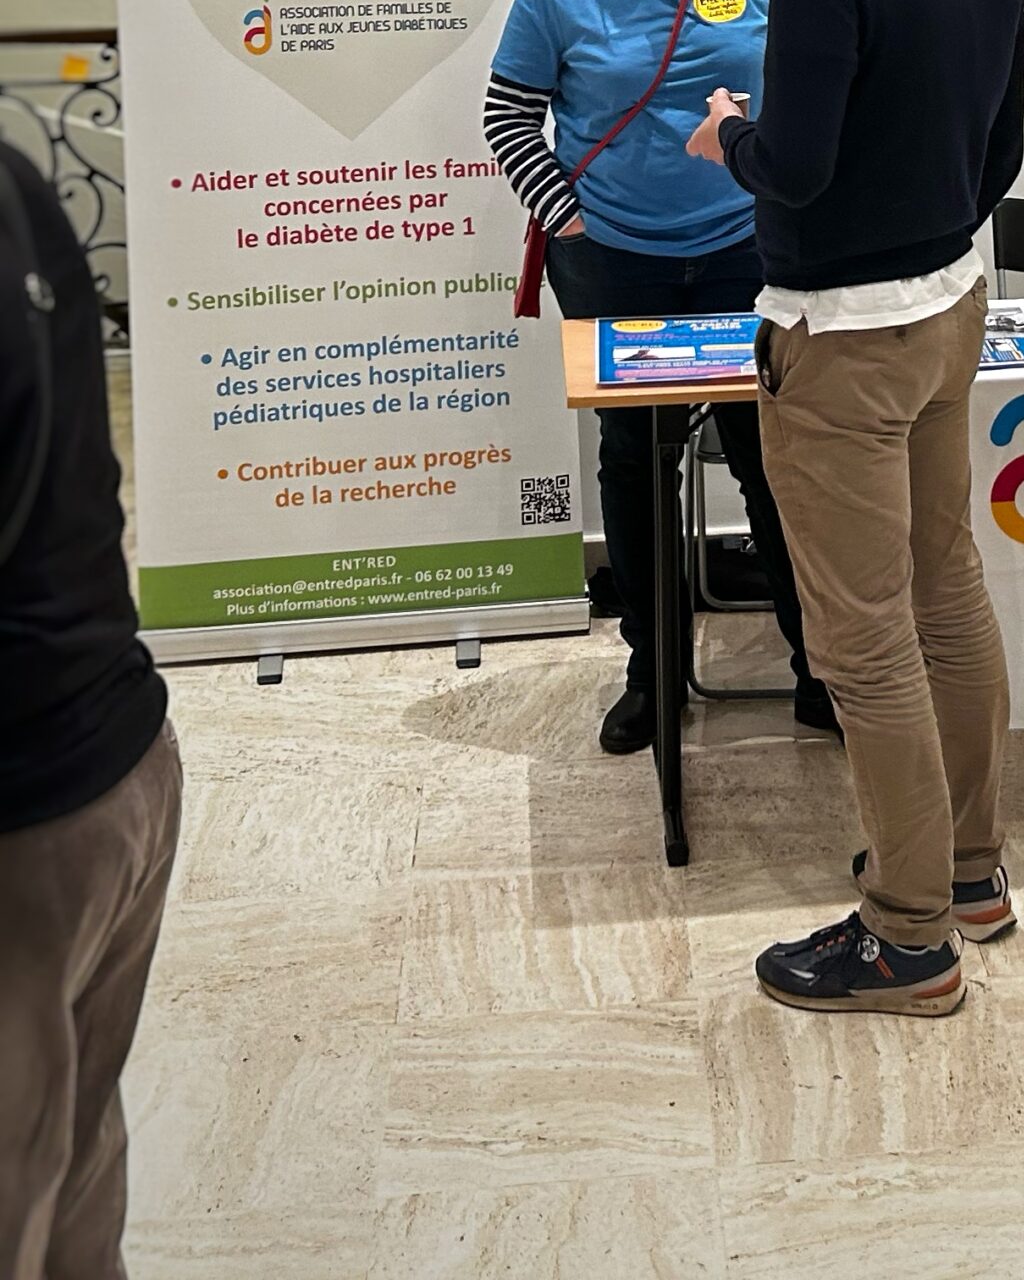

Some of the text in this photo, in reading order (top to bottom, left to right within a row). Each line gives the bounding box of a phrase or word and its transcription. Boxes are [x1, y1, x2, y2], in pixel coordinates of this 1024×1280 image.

[280, 2, 452, 19] ASSOCIATION DE FAMILLES DE
[280, 17, 468, 36] L'AIDE AUX JEUNES DIABÉTIQUES
[281, 38, 335, 52] DE PARIS
[191, 171, 258, 192] Aider
[265, 170, 289, 187] et
[297, 161, 397, 186] soutenir
[405, 159, 437, 179] les
[264, 191, 448, 217] concernées par
[237, 217, 475, 248] le diabète de type 1
[187, 272, 546, 311] Sensibiliser l'opinion publiq
[221, 328, 519, 370] Agir en complémentarité
[216, 360, 506, 396] des services hospitaliers
[213, 387, 511, 431] pédiatriques de la région
[238, 443, 511, 482] Contribuer aux progrès
[275, 477, 456, 508] de la recherche
[333, 555, 396, 571] ENT'RED
[213, 572, 403, 599] association@entredparis.fr
[414, 570, 432, 583] 06
[435, 568, 452, 582] 62
[456, 567, 473, 580] 00
[477, 565, 493, 578] 13
[496, 563, 514, 576] 49
[226, 603, 255, 616] Plus
[258, 596, 357, 614] d'informations
[368, 582, 502, 605] www.entred-paris.fr
